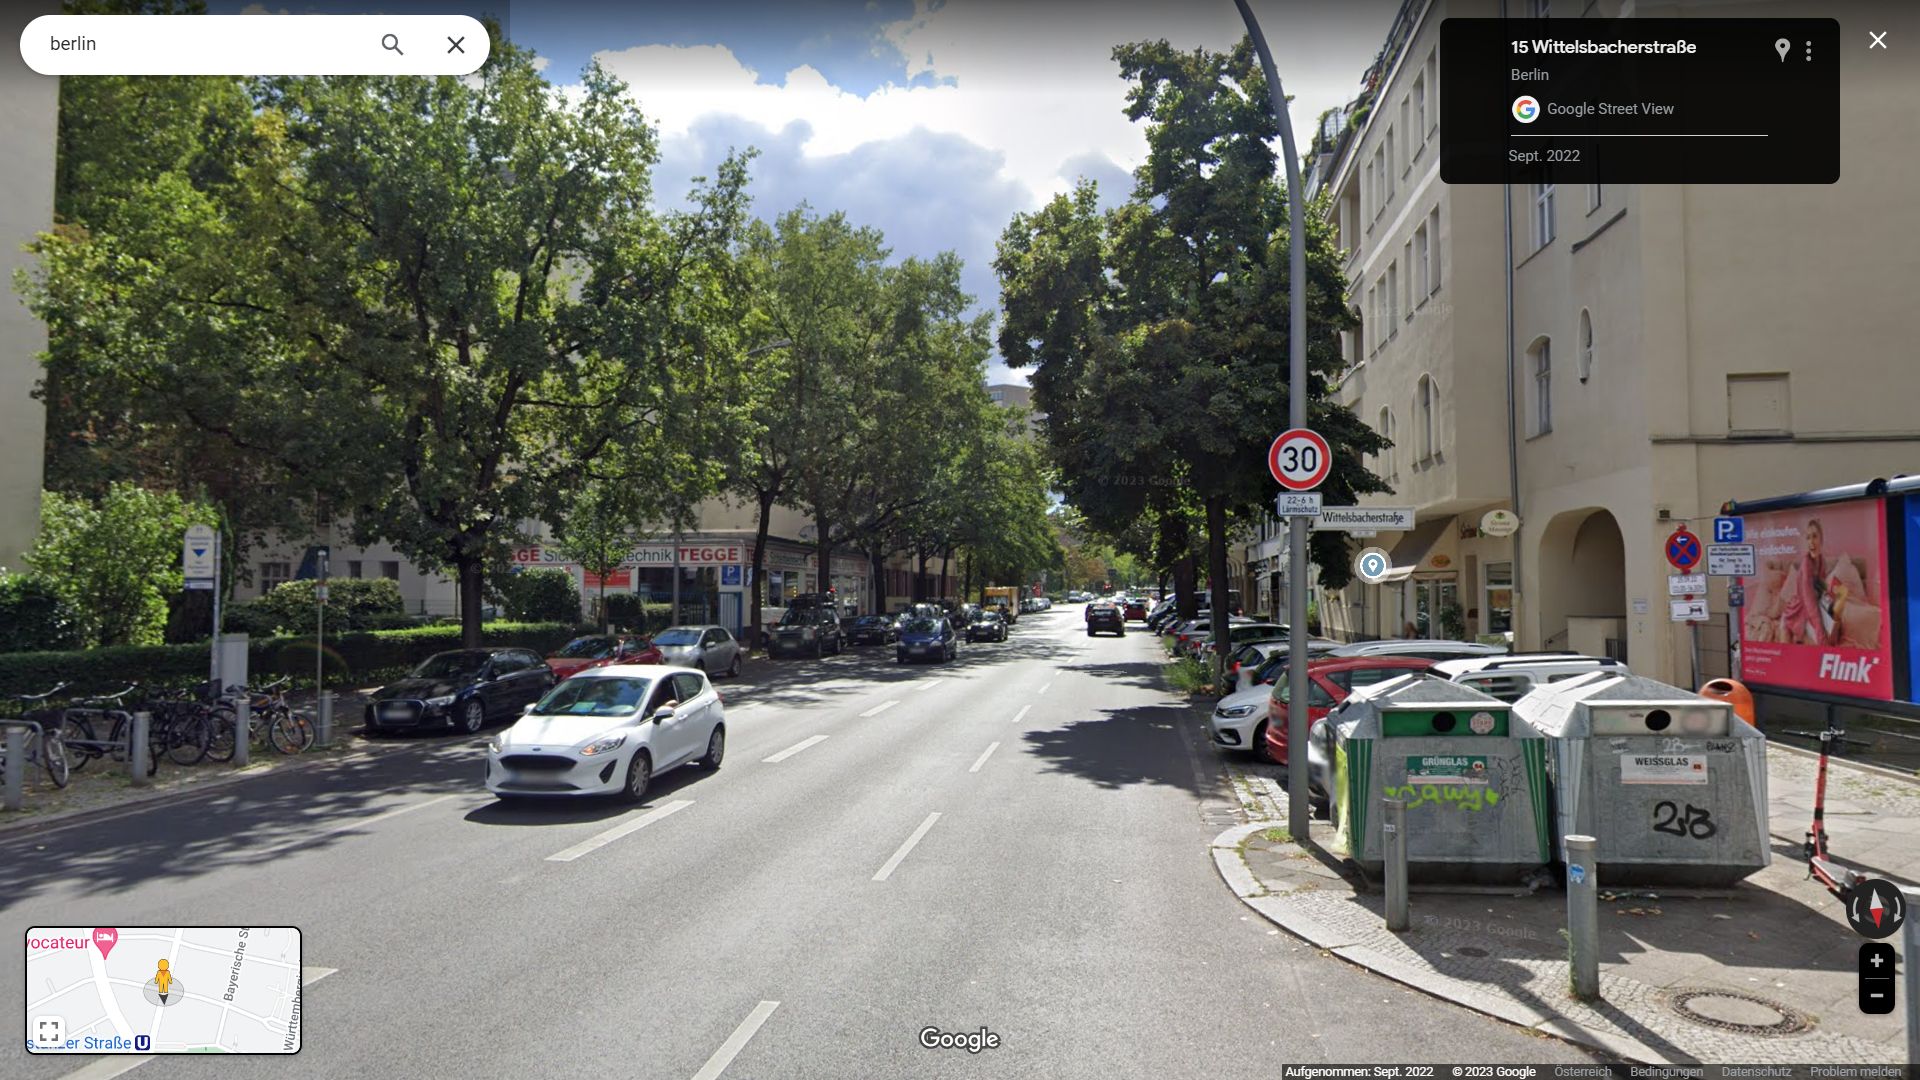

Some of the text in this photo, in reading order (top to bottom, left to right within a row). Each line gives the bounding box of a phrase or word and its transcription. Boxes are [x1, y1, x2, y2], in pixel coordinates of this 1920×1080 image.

[1282, 446, 1317, 473] 30
[1286, 495, 1314, 505] 22-6 h
[1281, 504, 1319, 514] Lärmschutz
[1322, 510, 1405, 526] Wittelsbacherstraße
[1717, 520, 1735, 540] P
[678, 547, 738, 562] TEGGE
[1818, 652, 1873, 684] Flink
[1422, 755, 1469, 767] GRÜNGLAS
[1635, 756, 1689, 767] WEISSGLAS
